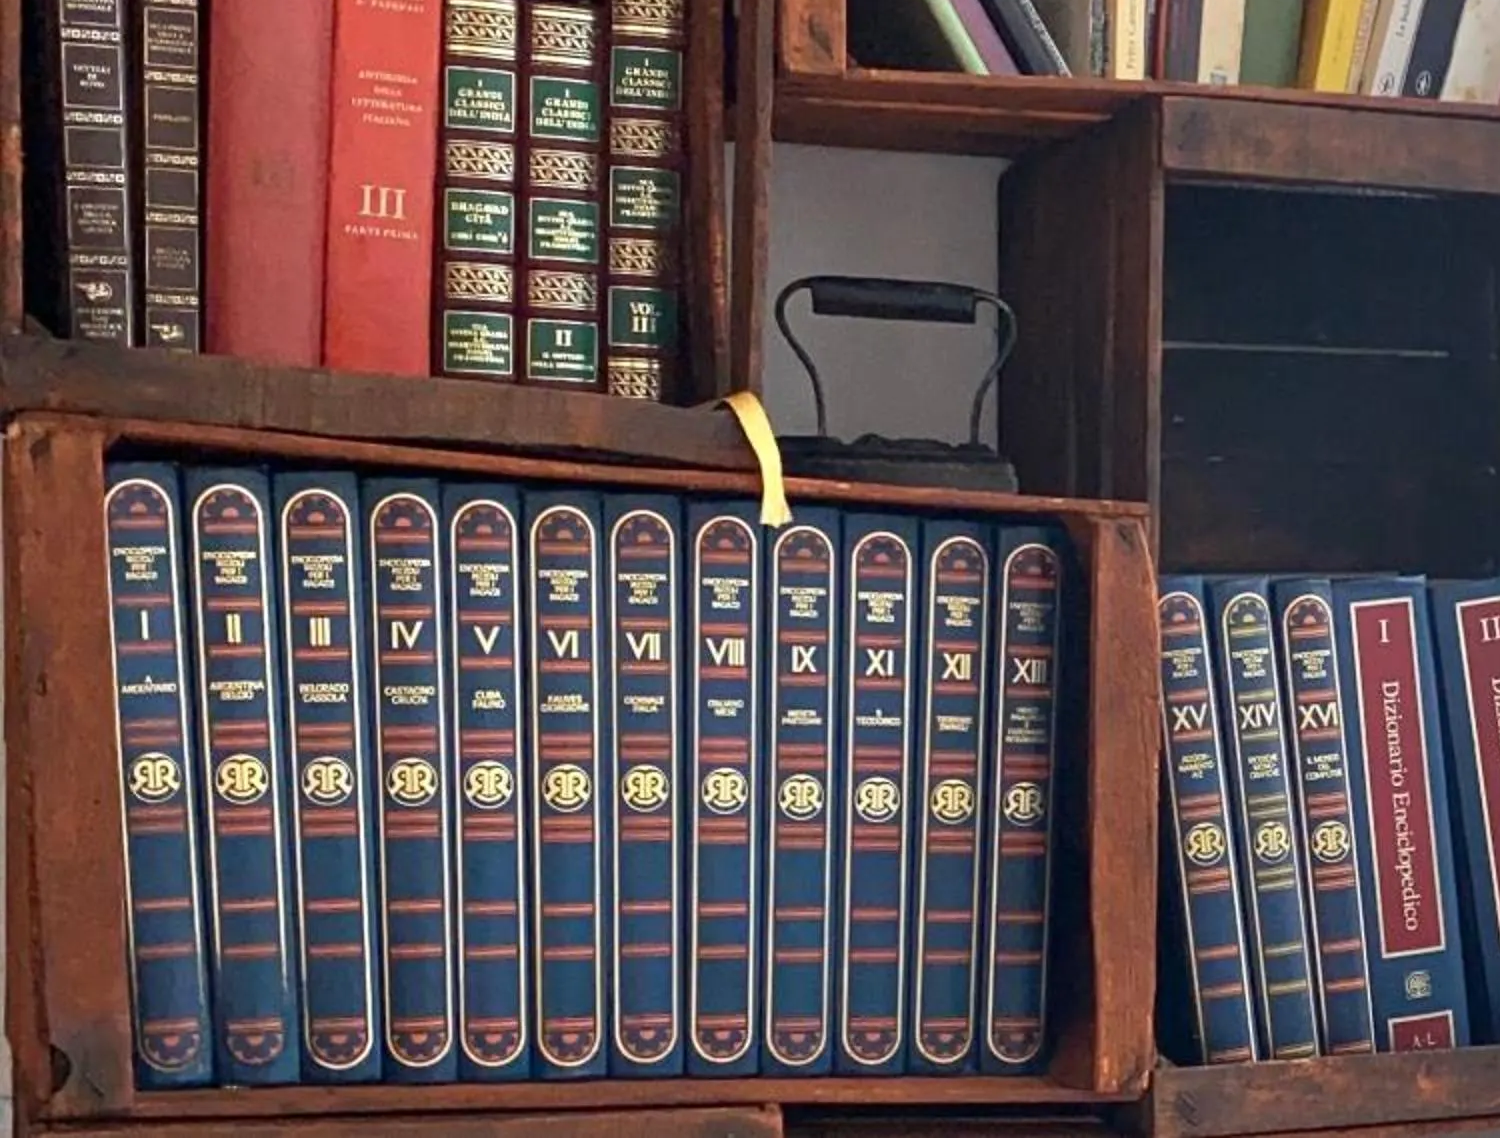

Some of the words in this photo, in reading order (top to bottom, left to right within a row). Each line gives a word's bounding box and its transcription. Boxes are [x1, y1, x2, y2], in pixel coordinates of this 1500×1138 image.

[359, 184, 407, 220] III
[345, 225, 381, 236] PARTE
[554, 329, 573, 346] II
[226, 613, 242, 643] II
[309, 617, 331, 646] III
[391, 621, 423, 649] IV
[474, 626, 500, 655] V
[1378, 618, 1390, 644] I
[548, 630, 579, 658] VI
[626, 632, 661, 660] VII
[706, 637, 745, 666] VIII
[791, 646, 817, 672] IX
[866, 649, 894, 676] XI
[942, 653, 971, 680] XII
[1172, 702, 1208, 731] XV
[1239, 702, 1276, 729] XIV
[1299, 702, 1339, 729] XVI
[1381, 680, 1406, 787] Dizionario
[1392, 790, 1421, 932] Enciclopedico
